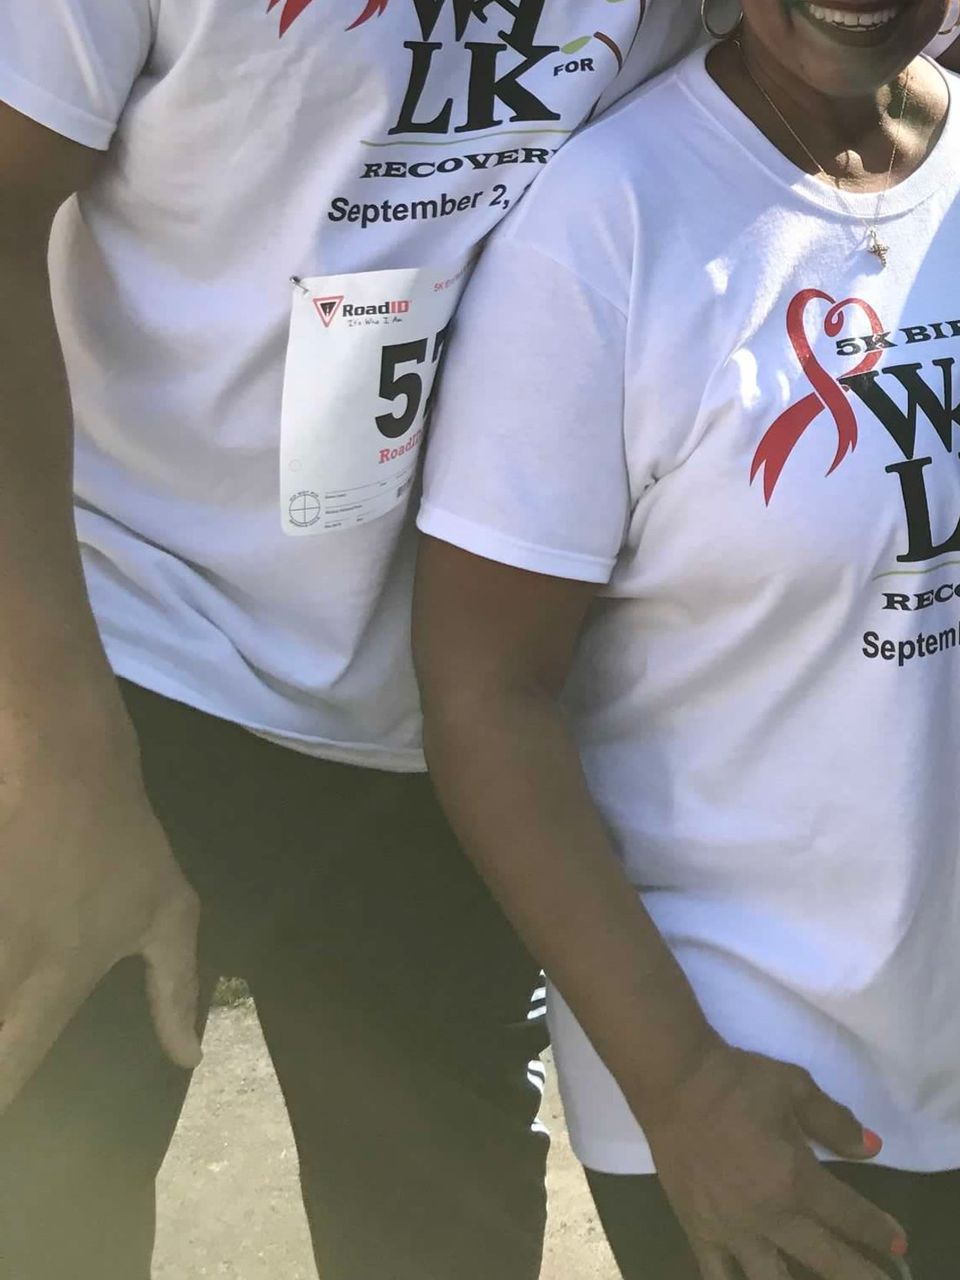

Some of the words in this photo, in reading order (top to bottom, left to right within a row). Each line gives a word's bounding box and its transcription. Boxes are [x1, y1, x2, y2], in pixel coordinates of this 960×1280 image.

[553, 57, 595, 77] FOR
[328, 192, 483, 228] September
[489, 184, 510, 210] 2,
[342, 300, 410, 318] RoadID
[836, 331, 898, 356] 5K
